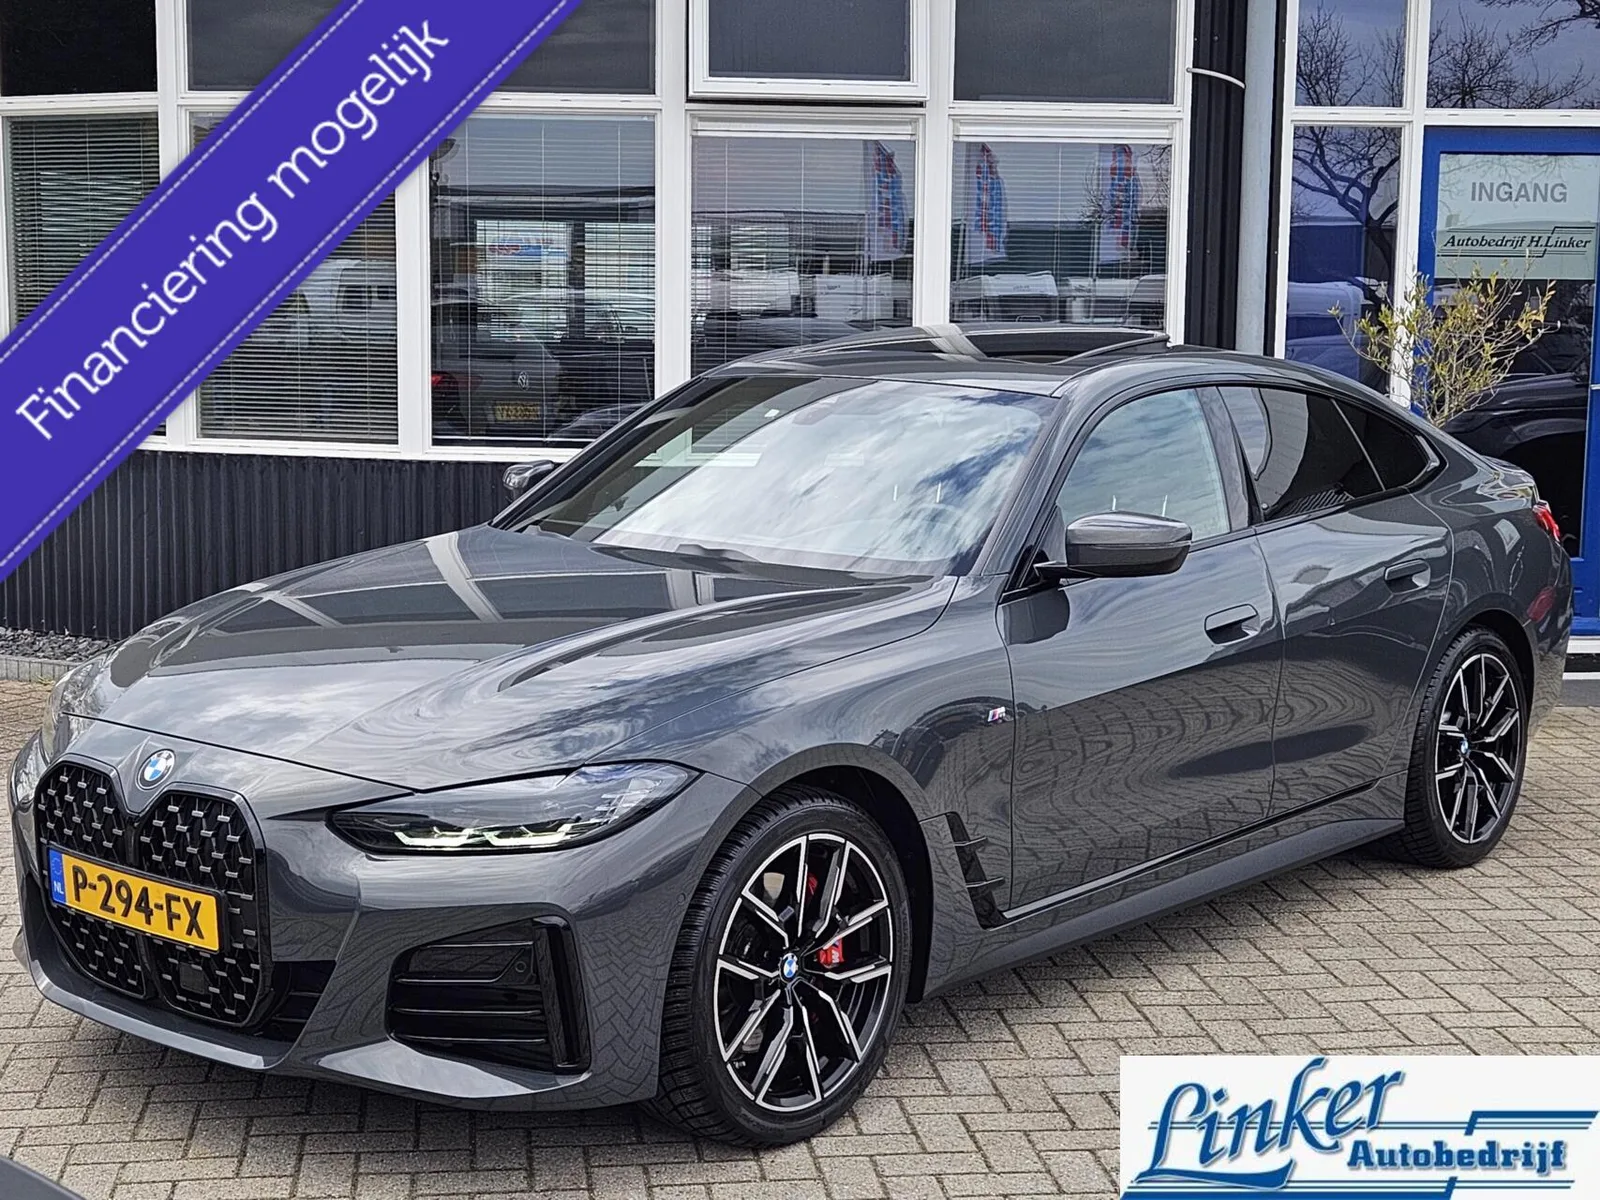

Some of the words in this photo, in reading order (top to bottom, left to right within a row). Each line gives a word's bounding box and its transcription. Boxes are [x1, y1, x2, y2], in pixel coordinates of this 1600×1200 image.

[1471, 182, 1568, 203] INGANG
[1443, 235, 1527, 249] Autobedrijf
[53, 881, 65, 895] NL
[72, 865, 205, 940] P-294-FX
